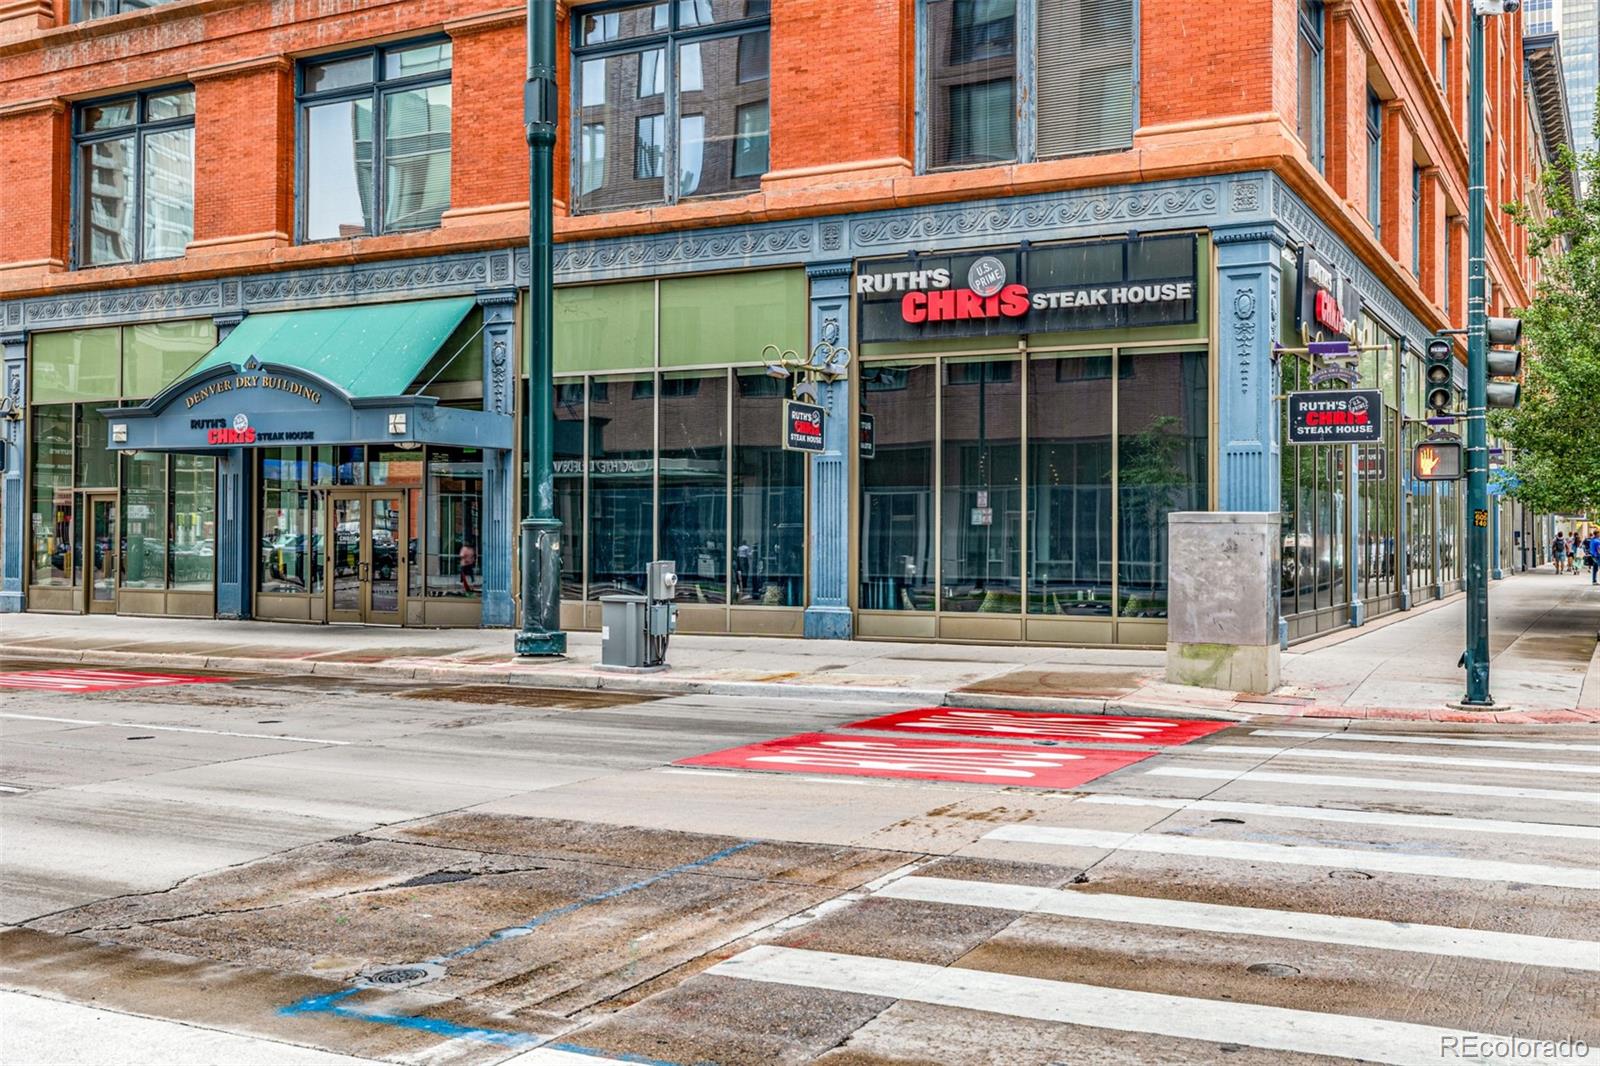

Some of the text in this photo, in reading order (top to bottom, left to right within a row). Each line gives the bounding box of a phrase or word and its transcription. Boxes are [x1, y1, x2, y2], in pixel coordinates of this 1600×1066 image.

[976, 262, 993, 277] U.S.
[857, 267, 951, 294] RUTH'S
[975, 269, 1003, 290] PRIME
[901, 283, 1193, 325] CHRIS STEAK HOUSE
[185, 375, 322, 409] DENVER DRY BUILDING
[1299, 400, 1347, 411] RUTH'S
[190, 418, 227, 429] RUTH'S
[792, 411, 812, 421] RUTH'S
[1305, 410, 1369, 426] CHRIS
[208, 427, 315, 444] CHRIS STEAK HOUSE
[1296, 425, 1374, 435] STEAK HOUSE
